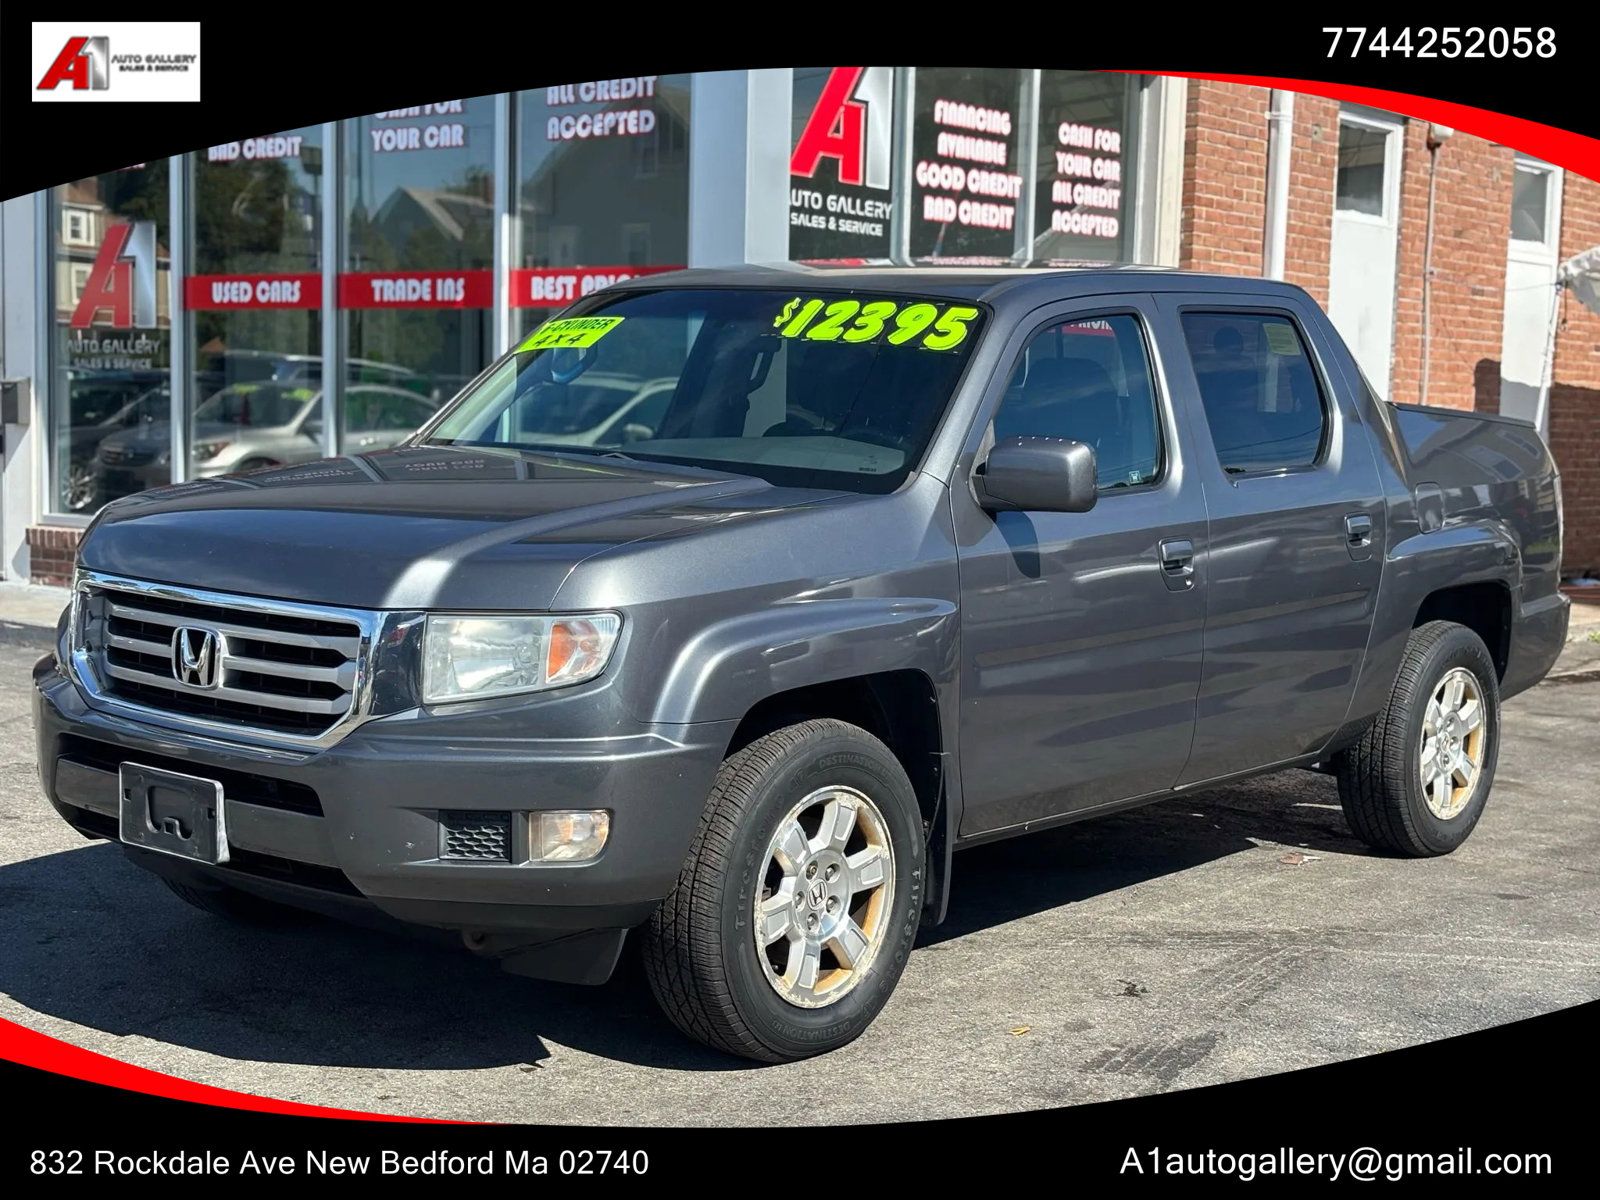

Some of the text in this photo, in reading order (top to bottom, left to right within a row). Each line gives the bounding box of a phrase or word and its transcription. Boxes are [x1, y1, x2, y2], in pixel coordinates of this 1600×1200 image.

[547, 77, 657, 107] ALL CREDIT
[547, 110, 656, 140] ACCEPTED
[934, 98, 1011, 136] FINANCING
[208, 136, 302, 161] BAD CREDIT
[371, 124, 464, 152] YOUR CAR
[937, 133, 1007, 166] AVAILABLE
[1058, 122, 1122, 154] CASH FOR
[916, 162, 1024, 199] GOOD CREDIT
[1056, 151, 1122, 182] YOUR CAR
[790, 188, 893, 219] UTO GALLERY
[1052, 180, 1121, 211] ALL CREDIT
[791, 212, 884, 237] SALES & SERVICE
[924, 195, 1016, 231] BAD CREDIT
[1052, 211, 1119, 238] ACCEPTED
[211, 280, 301, 303] USED CARS
[371, 277, 465, 302] TRADE INS
[531, 275, 577, 300] BEST
[773, 297, 978, 352] $12395
[67, 339, 160, 354] AUTO GALLERY
[74, 358, 103, 369] SALES
[113, 357, 152, 370] SERVICE
